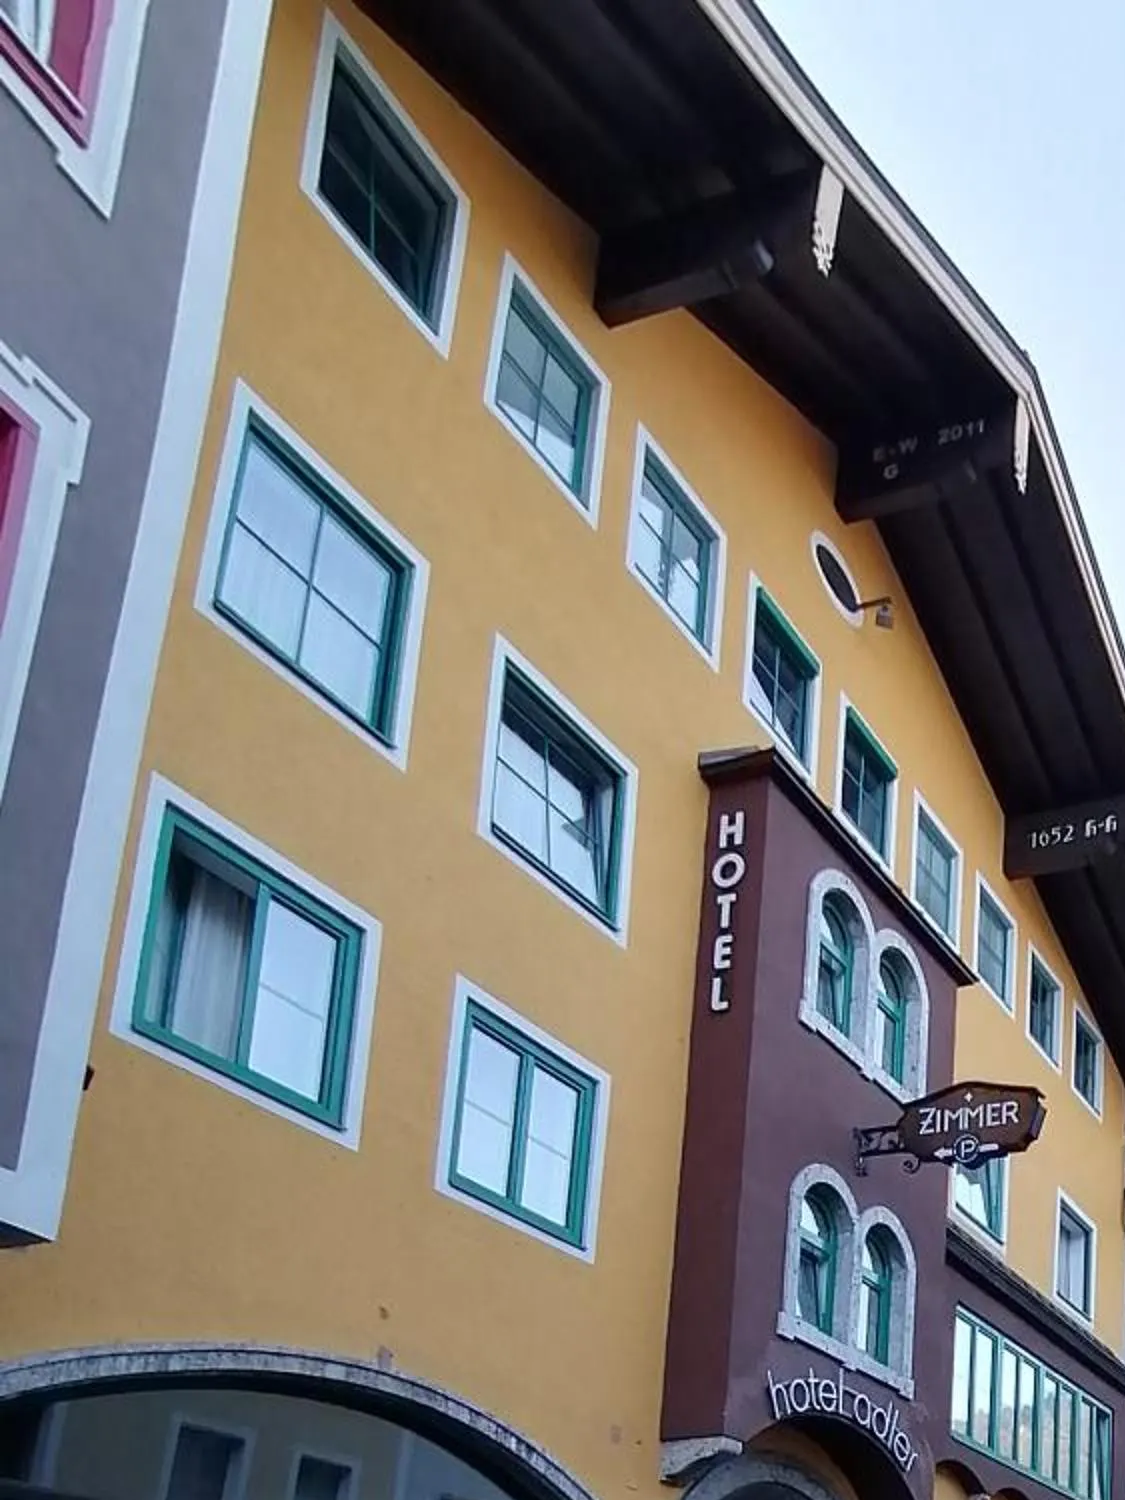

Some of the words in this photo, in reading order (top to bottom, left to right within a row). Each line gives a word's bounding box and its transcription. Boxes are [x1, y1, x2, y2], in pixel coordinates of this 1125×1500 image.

[938, 419, 984, 445] 2011
[711, 811, 746, 1012] HOTEL
[919, 1101, 1019, 1135] ZIMMER
[767, 1367, 846, 1421] hotel
[853, 1393, 919, 1473] adler
